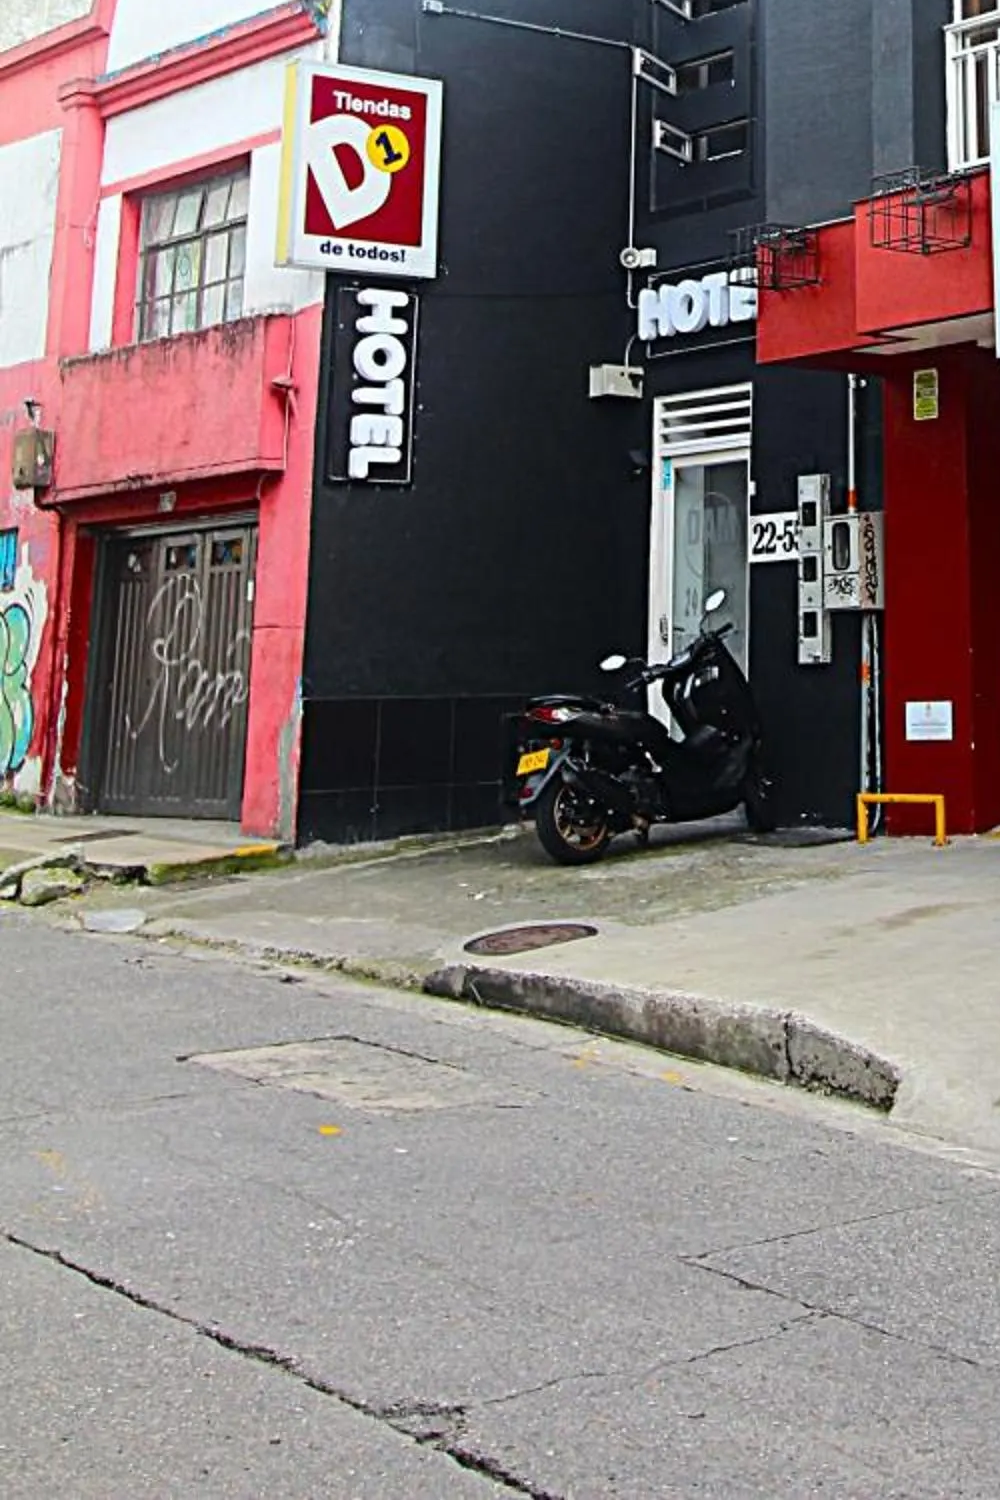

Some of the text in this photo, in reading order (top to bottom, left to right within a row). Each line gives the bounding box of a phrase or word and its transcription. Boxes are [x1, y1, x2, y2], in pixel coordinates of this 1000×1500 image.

[333, 90, 411, 120] Tiendas
[320, 241, 406, 263] de todos!
[638, 267, 758, 340] HOTE
[347, 287, 409, 479] HOTEL
